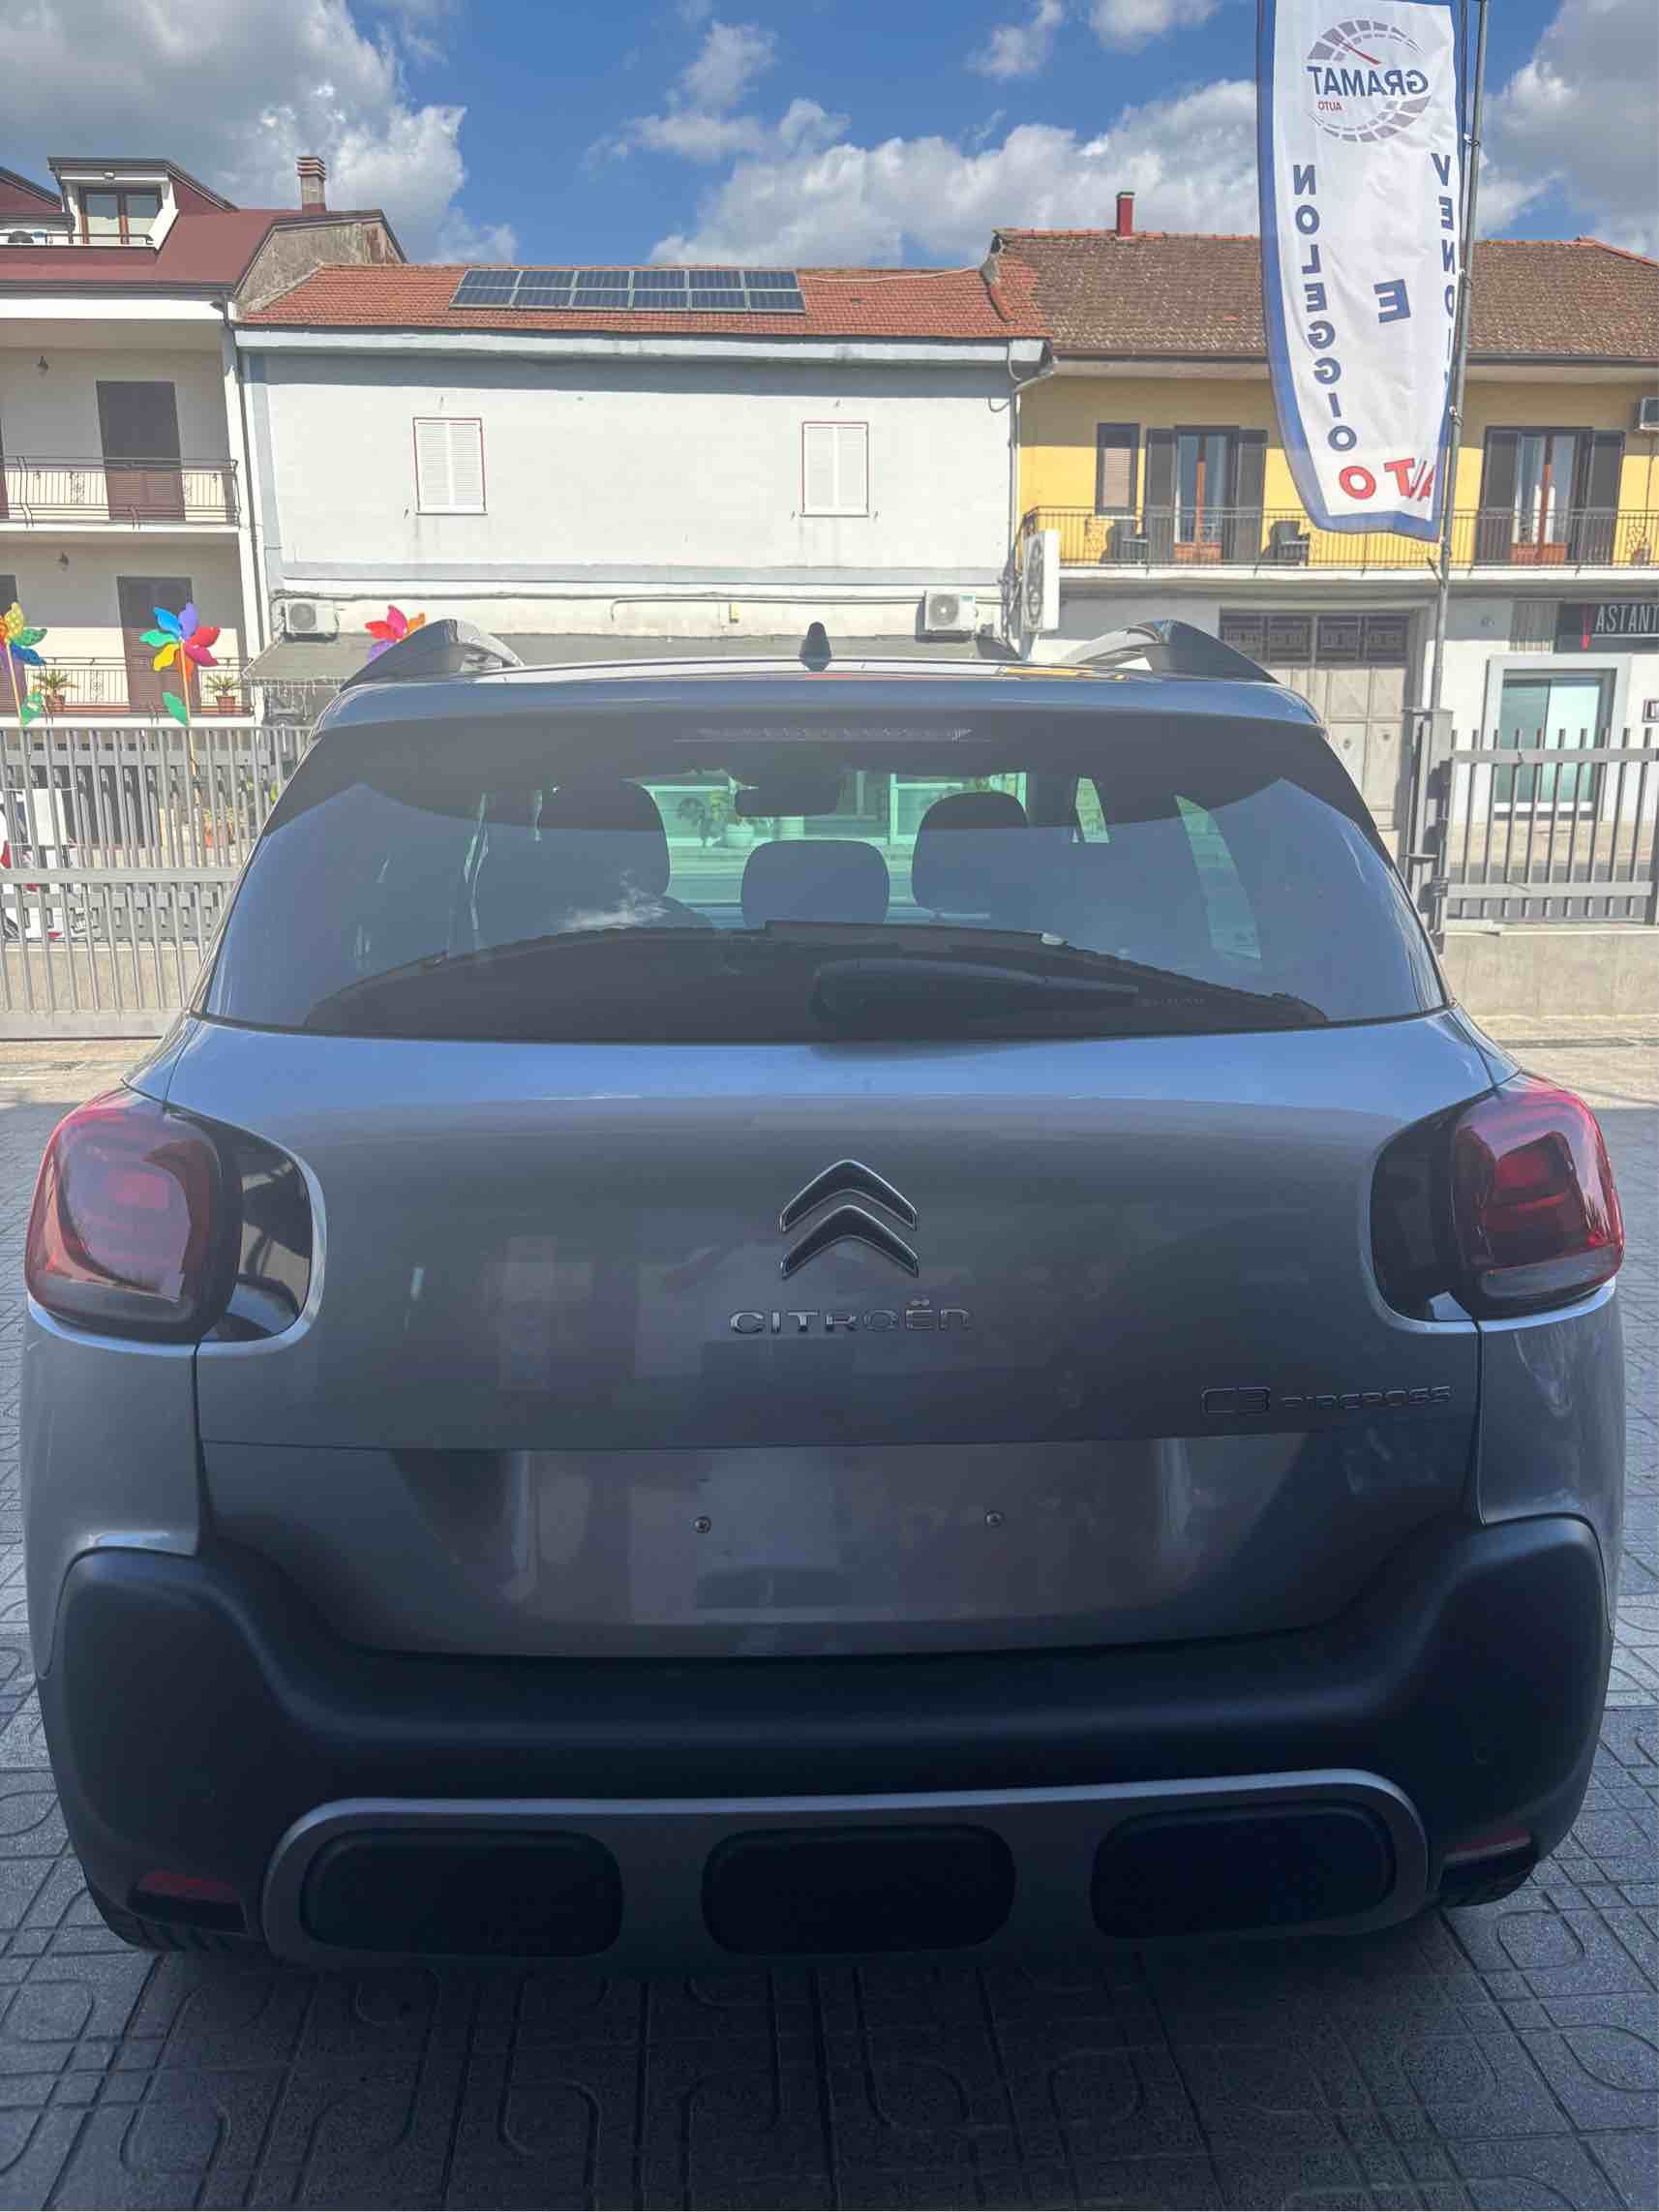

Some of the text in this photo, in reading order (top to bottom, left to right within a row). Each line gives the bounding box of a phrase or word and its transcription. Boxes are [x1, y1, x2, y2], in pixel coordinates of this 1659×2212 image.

[728, 1298, 974, 1334] CITROËN
[1200, 1385, 1456, 1417] C3 AIRCROSS
